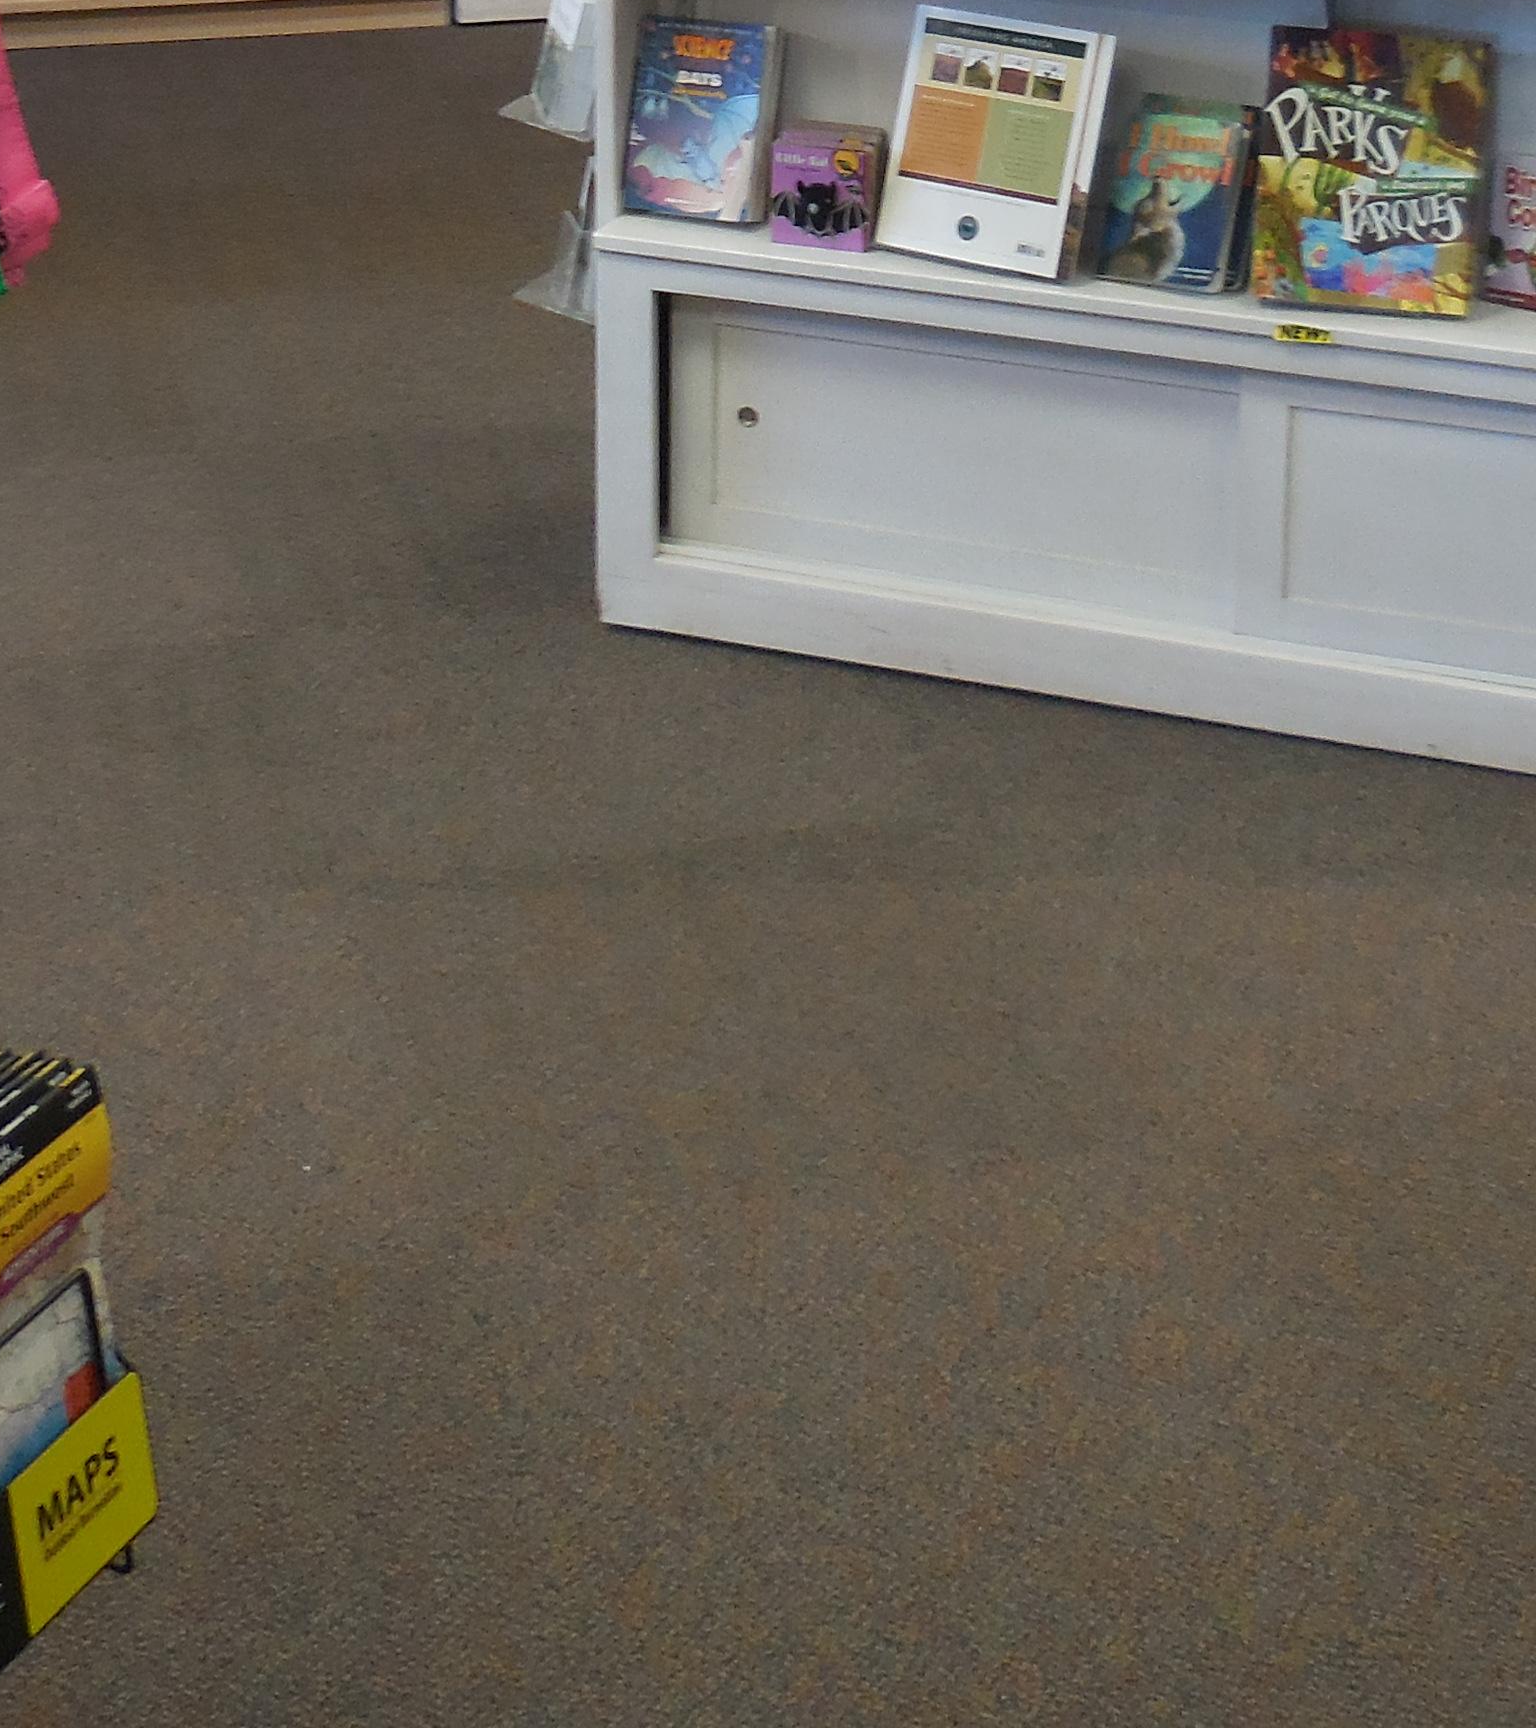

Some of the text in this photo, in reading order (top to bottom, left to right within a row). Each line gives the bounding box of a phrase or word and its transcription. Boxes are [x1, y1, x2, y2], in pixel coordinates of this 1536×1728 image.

[1266, 86, 1412, 177] PARKS
[1337, 185, 1468, 244] PARQUES
[34, 1141, 83, 1189] States
[0, 1176, 77, 1245] Southwest
[35, 1434, 121, 1543] MAPS
